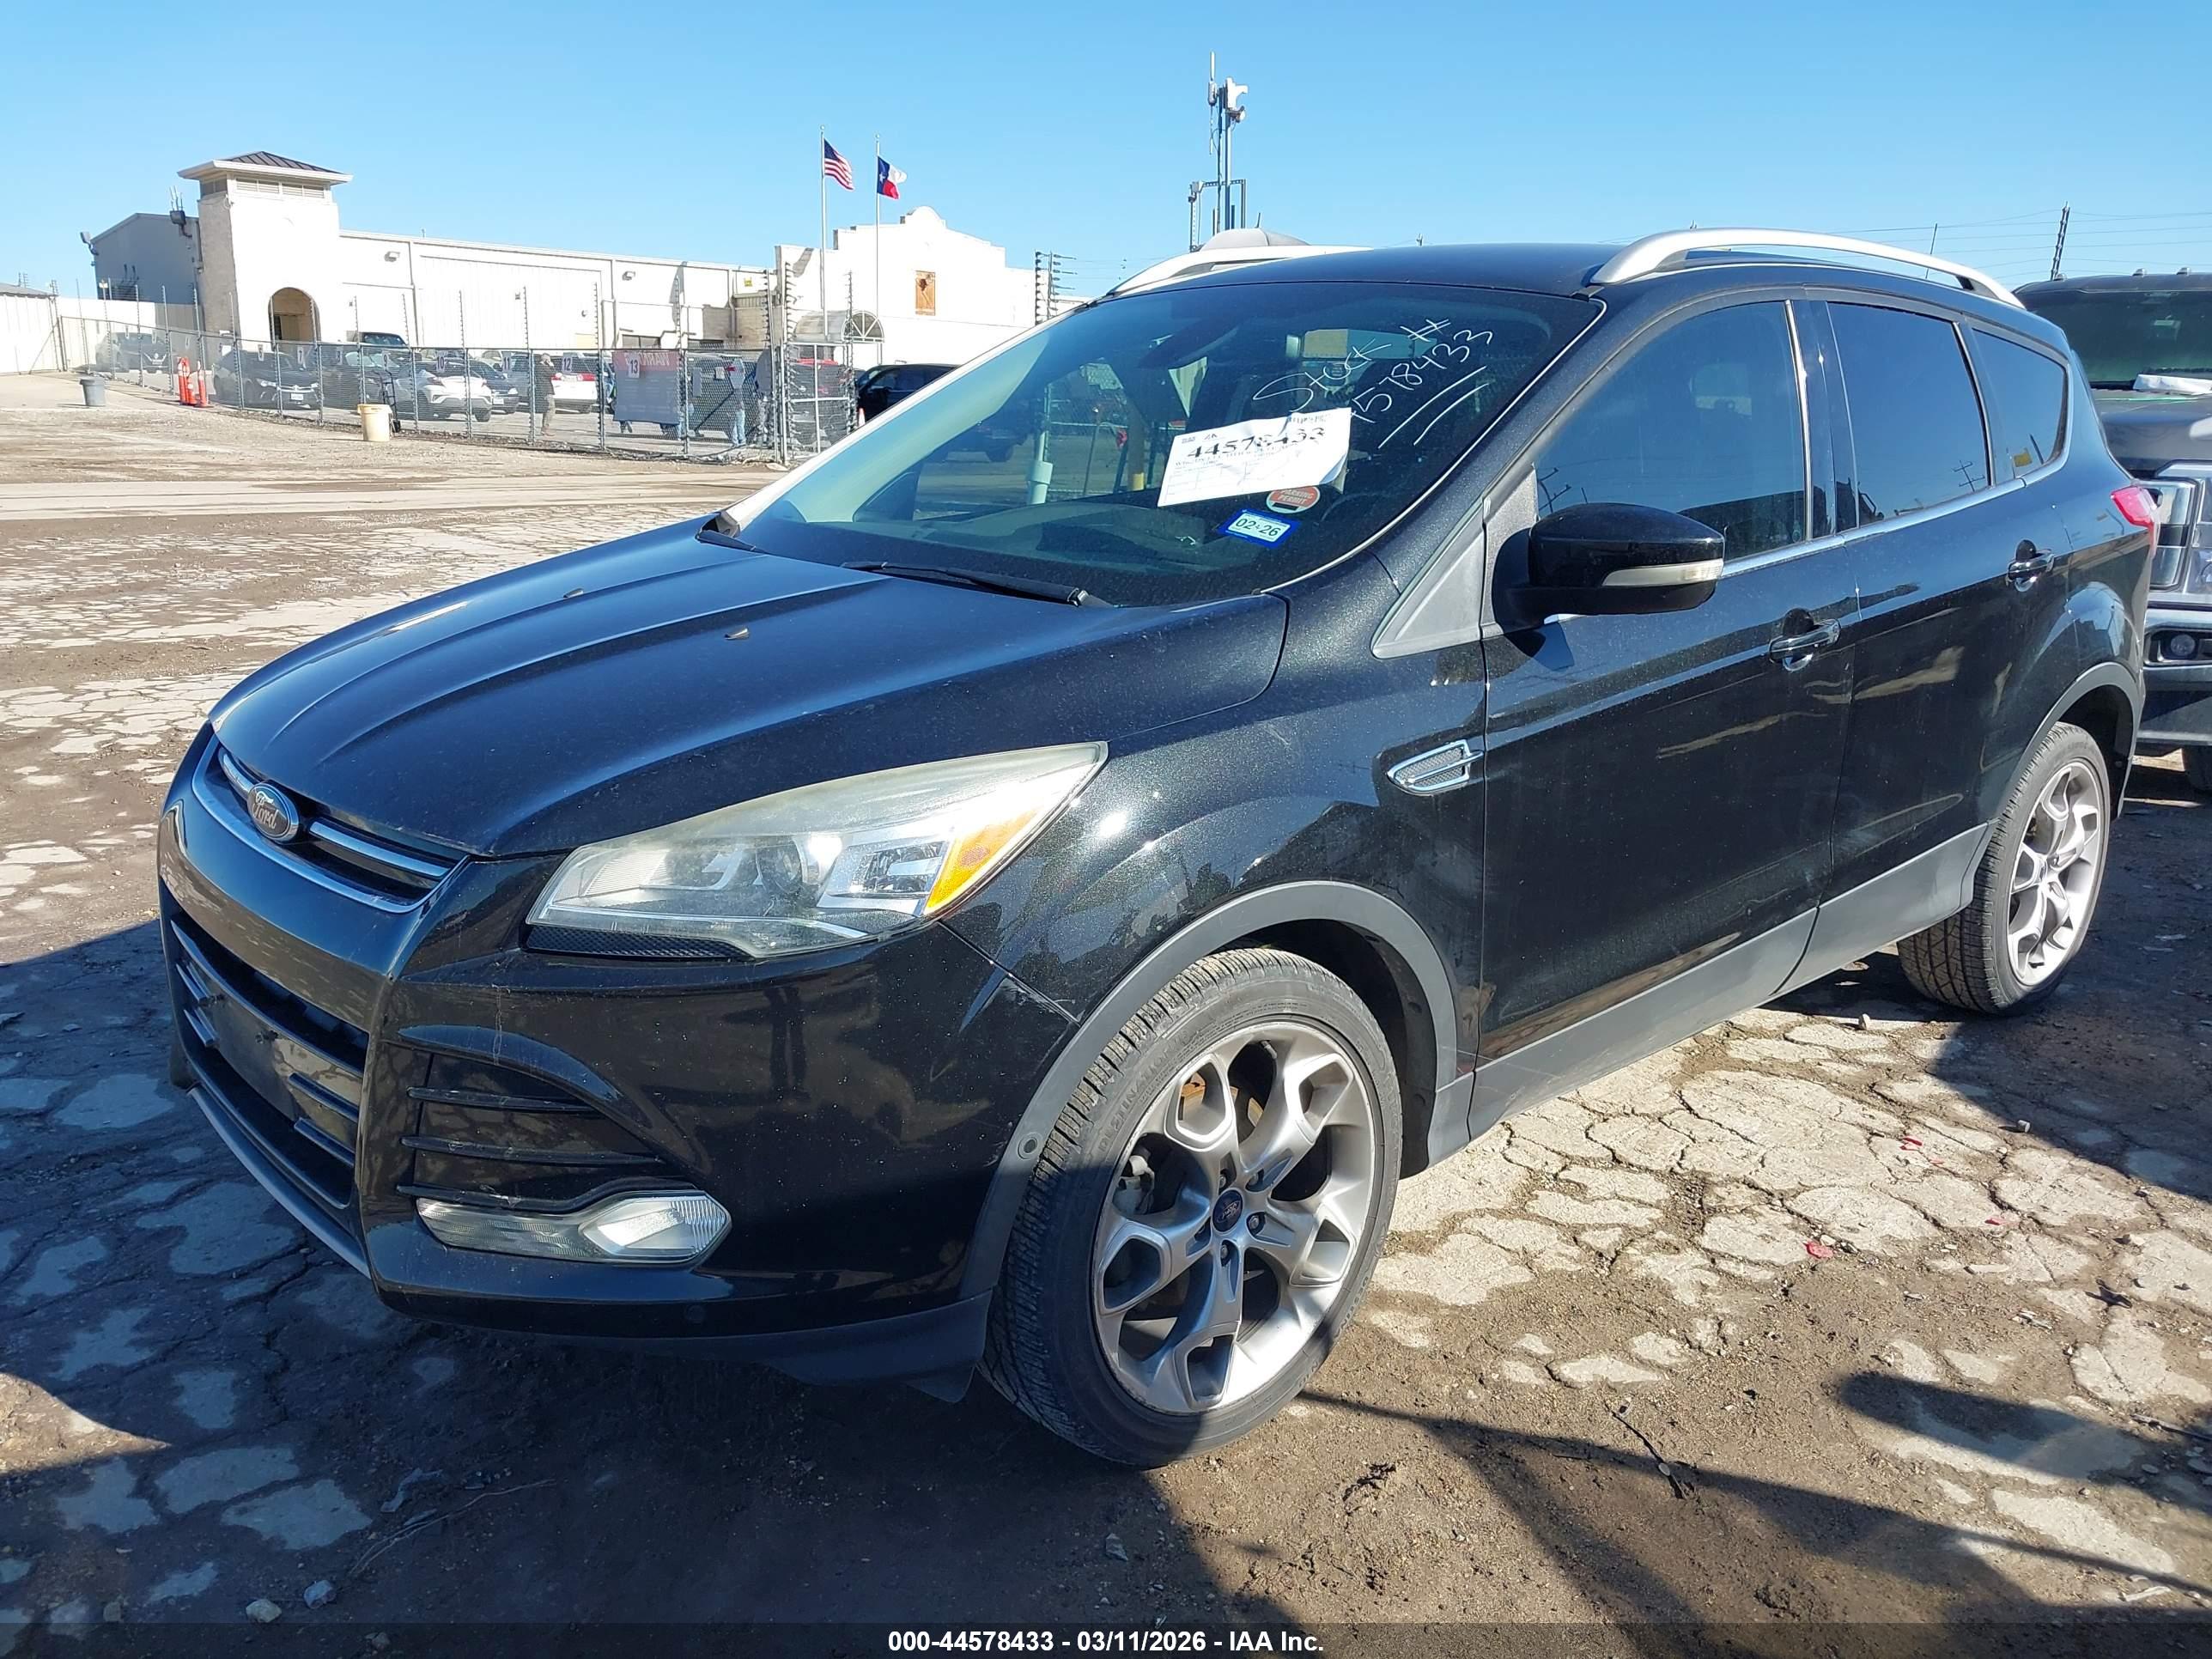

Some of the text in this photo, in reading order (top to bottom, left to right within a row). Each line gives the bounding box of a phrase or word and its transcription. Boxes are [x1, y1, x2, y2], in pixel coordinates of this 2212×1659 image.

[436, 356, 445, 369] 10
[503, 356, 511, 368] 11
[563, 357, 572, 370] 12
[629, 359, 639, 374] 13
[1252, 338, 1392, 412] Stock
[1277, 494, 1307, 505] PERMIT
[1235, 518, 1257, 531] 02
[1258, 525, 1281, 537] 26
[252, 790, 277, 829] Ford
